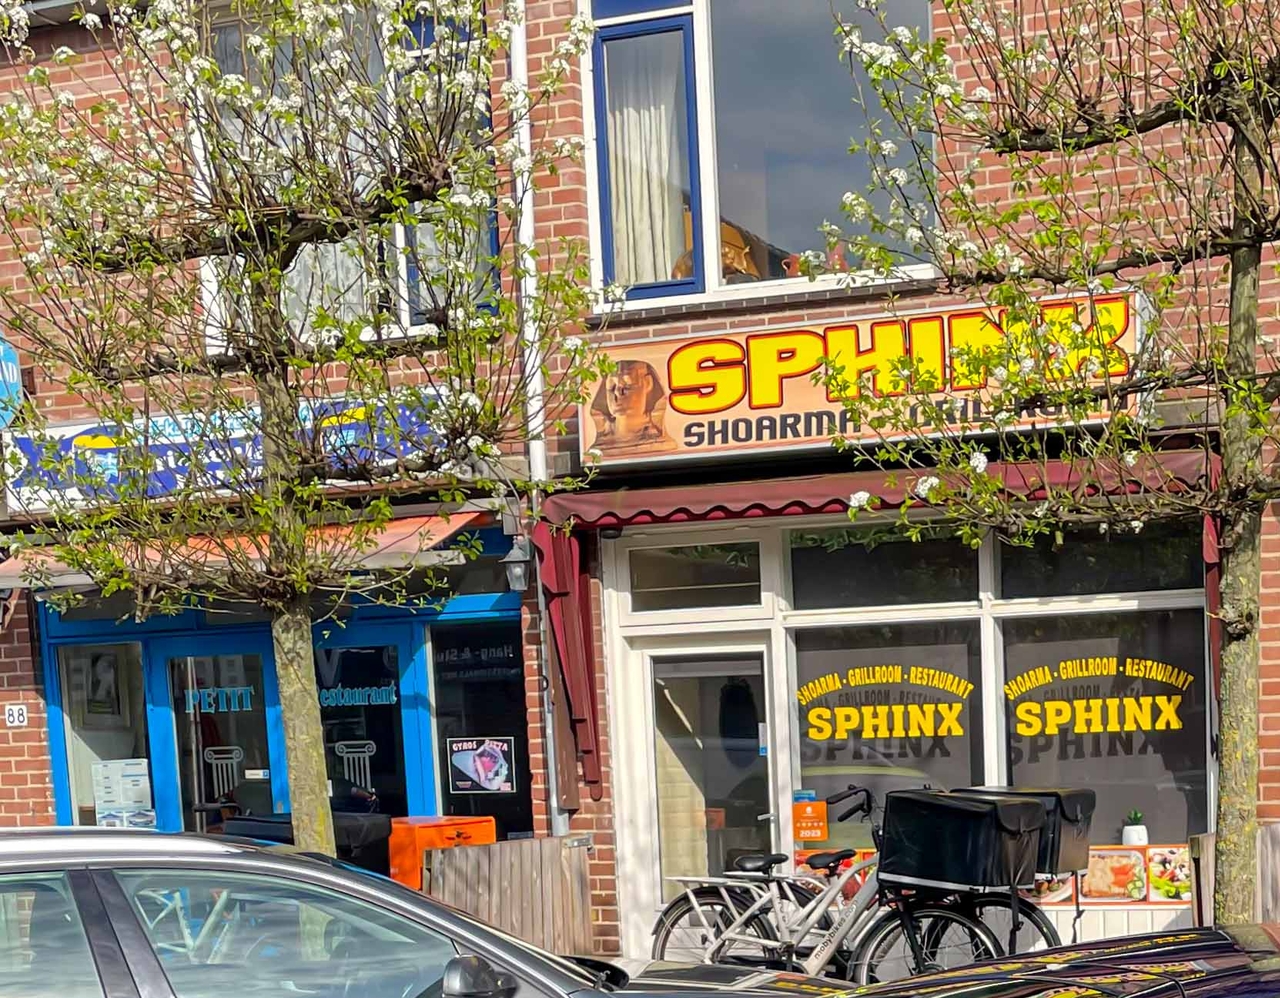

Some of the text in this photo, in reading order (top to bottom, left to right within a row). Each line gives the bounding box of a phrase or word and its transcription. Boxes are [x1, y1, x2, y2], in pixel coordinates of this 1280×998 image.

[667, 292, 1130, 416] SPHINX
[683, 409, 861, 448] SHOARMA
[184, 680, 398, 714] PETIT estaurant
[796, 665, 975, 706] SHOARMA GRILLROOM RESTAURANT
[1004, 657, 1195, 701] SHOARMA GRILLROOM RESTAURANT
[7, 707, 26, 724] 88
[807, 702, 965, 741] SPHINX
[1015, 694, 1184, 737] SPHINX
[799, 829, 821, 838] 2023
